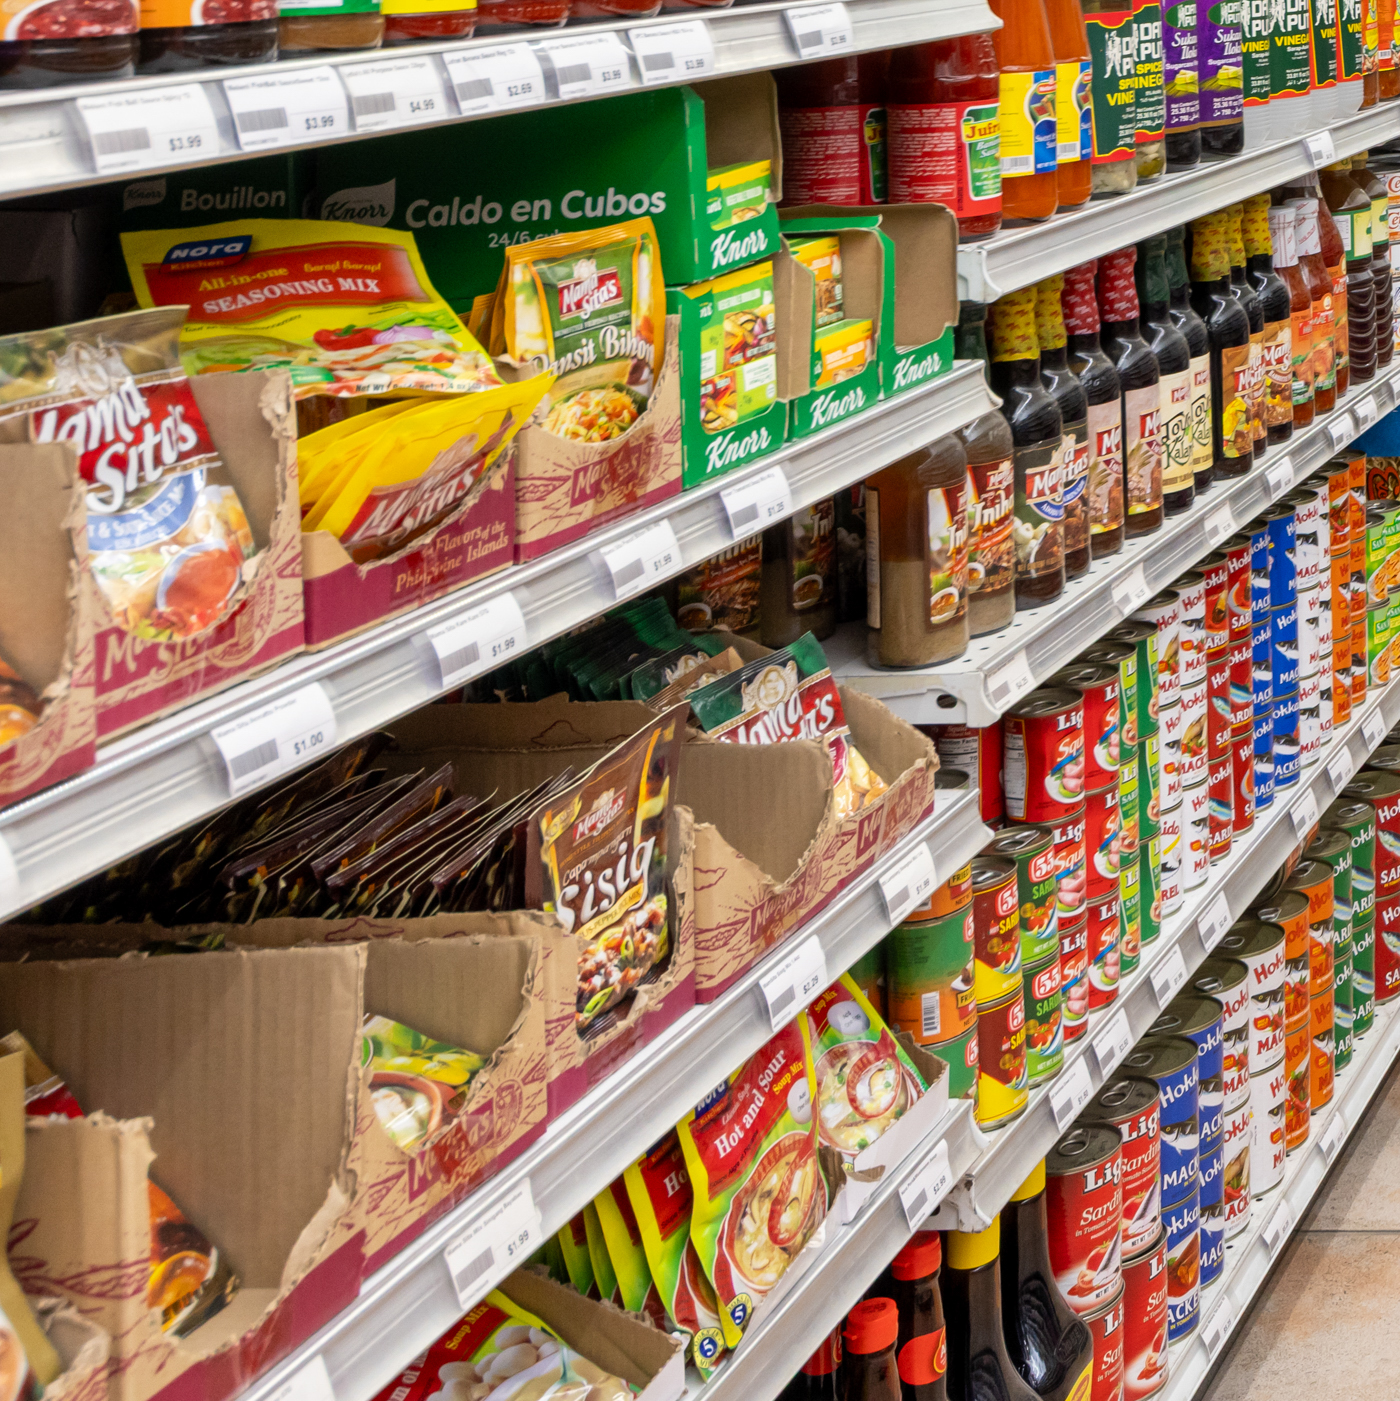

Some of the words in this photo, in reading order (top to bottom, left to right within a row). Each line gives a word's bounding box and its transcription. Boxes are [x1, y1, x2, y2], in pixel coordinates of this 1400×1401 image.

[410, 99, 434, 113] $4.99
[305, 116, 334, 130] $3.99
[169, 135, 201, 151] $3.99
[181, 186, 285, 212] Bouillon
[324, 199, 388, 227] Knorr
[406, 195, 502, 228] Caldo
[511, 198, 552, 222] en
[561, 188, 666, 219] Cubos
[710, 228, 768, 270] Knorr
[199, 264, 288, 292] All-in-one
[204, 279, 333, 314] SEASONING
[339, 277, 380, 294] MIX
[600, 326, 655, 362] Bihon
[810, 386, 866, 429] Knorr
[706, 427, 771, 473] Knorr
[435, 526, 483, 559] Flavors
[493, 641, 514, 656] $1.99
[295, 733, 322, 754] $1.00
[557, 836, 656, 939] Sisig
[713, 1123, 744, 1159] Hot
[744, 1095, 767, 1128] and
[759, 1050, 787, 1097] Sour
[506, 1230, 530, 1257] $1.99
